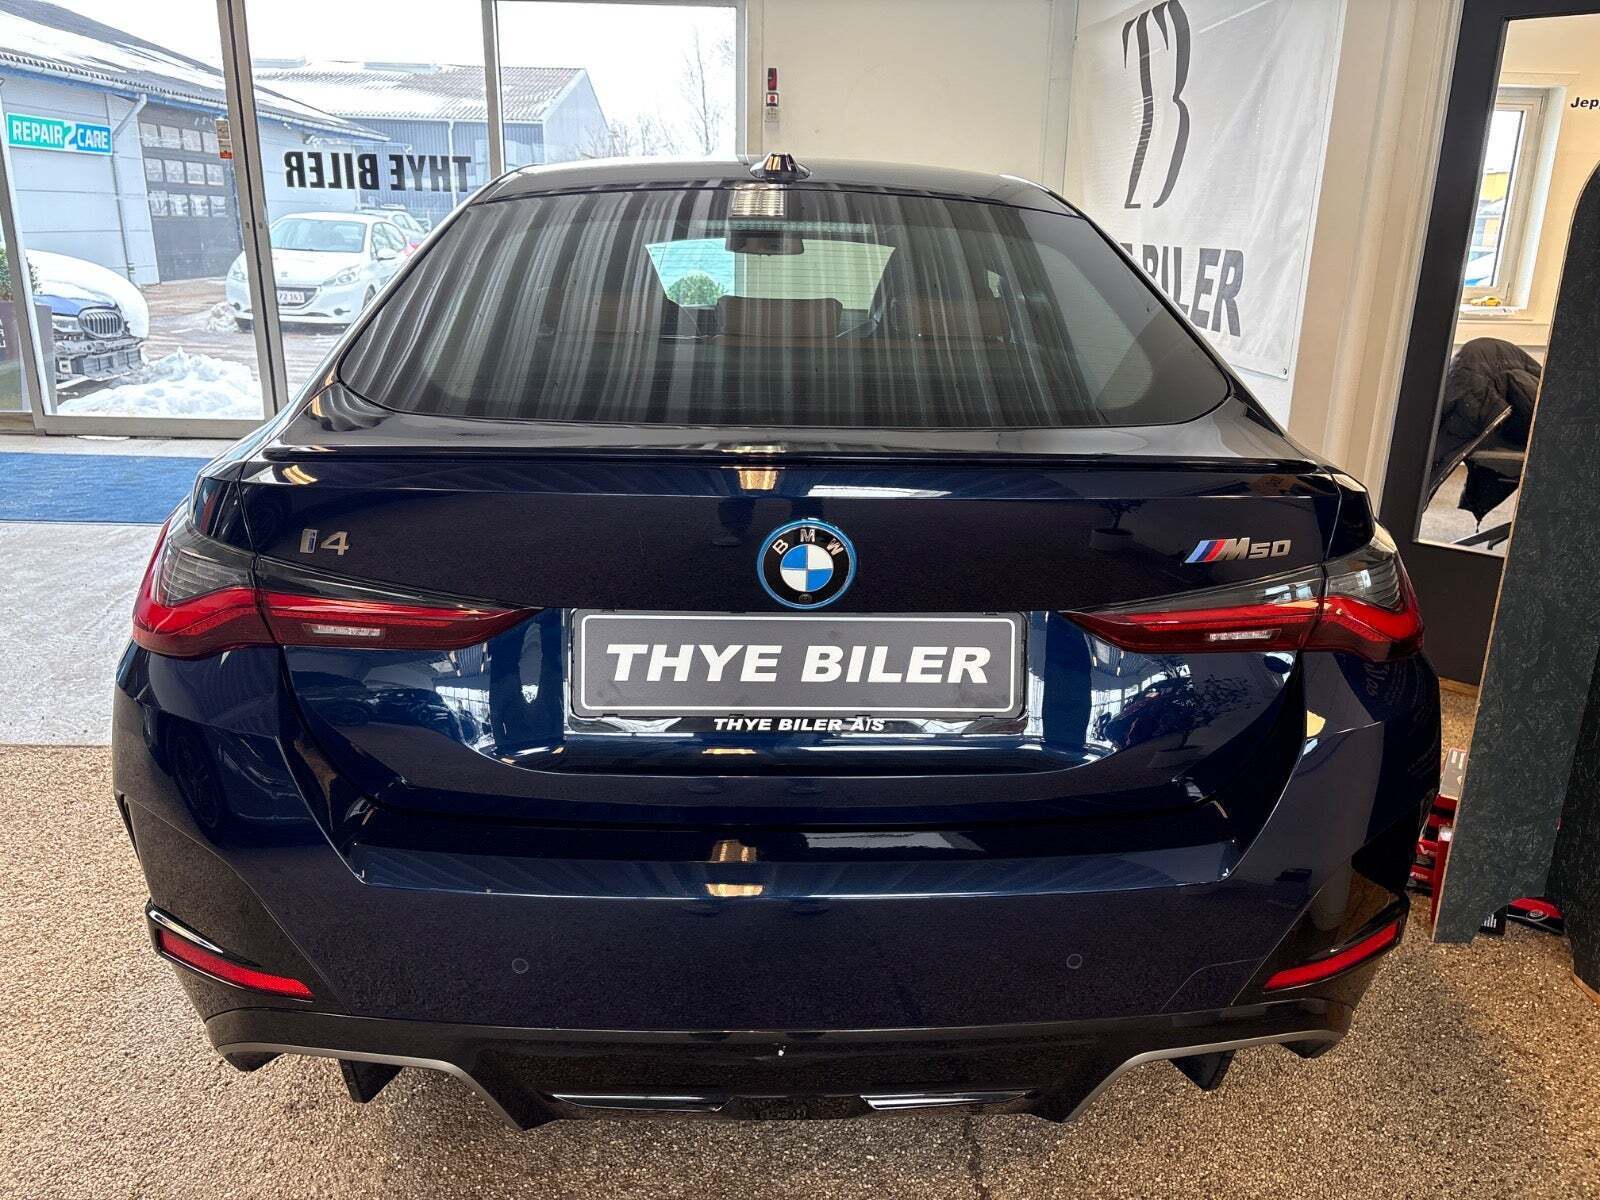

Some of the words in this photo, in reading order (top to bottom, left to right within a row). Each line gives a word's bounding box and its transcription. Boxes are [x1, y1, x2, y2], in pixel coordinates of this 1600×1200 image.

[1570, 96, 1600, 110] Jep
[772, 528, 844, 556] BMW
[606, 644, 783, 682] THYE
[800, 645, 991, 684] BILER
[713, 718, 772, 732] THYE
[777, 718, 843, 732] BILER
